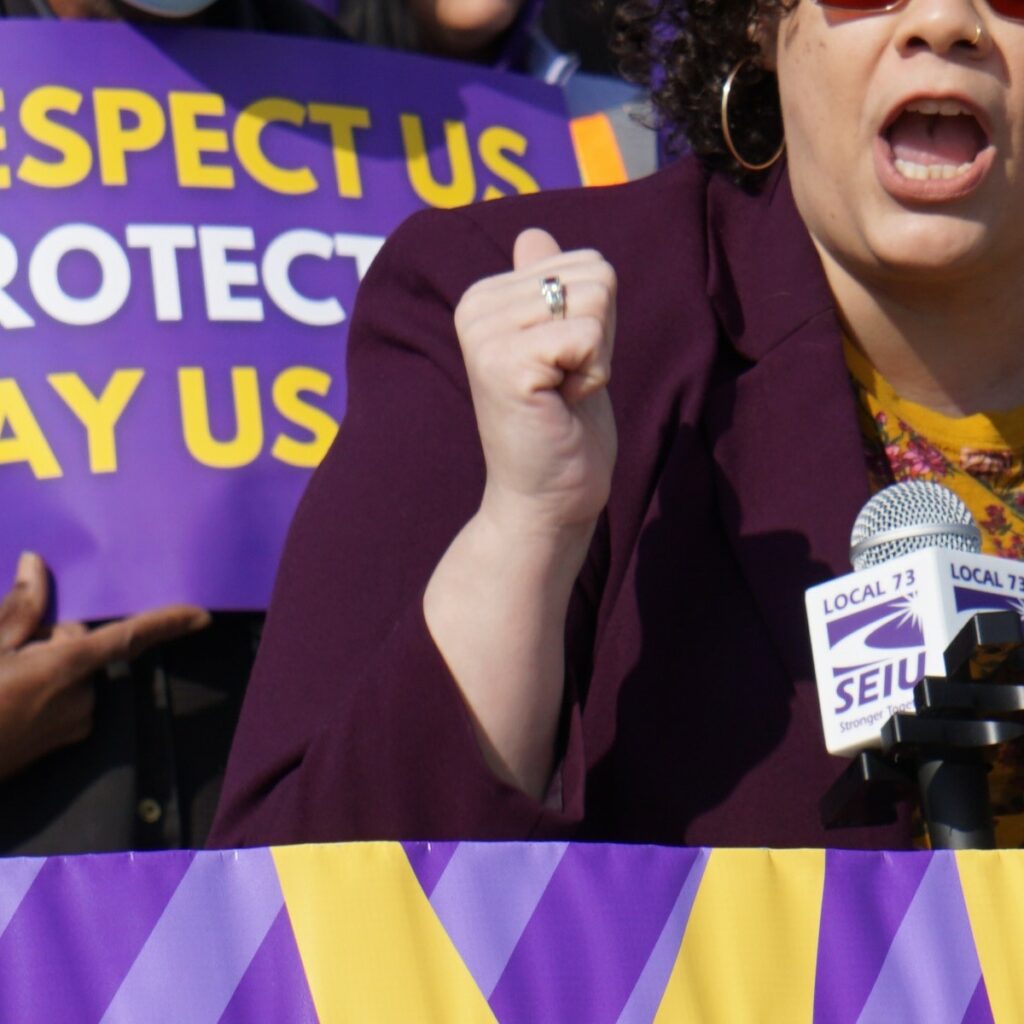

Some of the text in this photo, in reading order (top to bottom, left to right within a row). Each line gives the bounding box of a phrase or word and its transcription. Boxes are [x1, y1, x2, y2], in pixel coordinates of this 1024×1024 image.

[0, 85, 541, 211] SPECT US
[177, 366, 341, 469] US
[823, 568, 916, 615] LOCAL 73
[950, 563, 1004, 588] LOCAL
[834, 651, 927, 715] SEIU
[839, 710, 884, 734] Stronger
